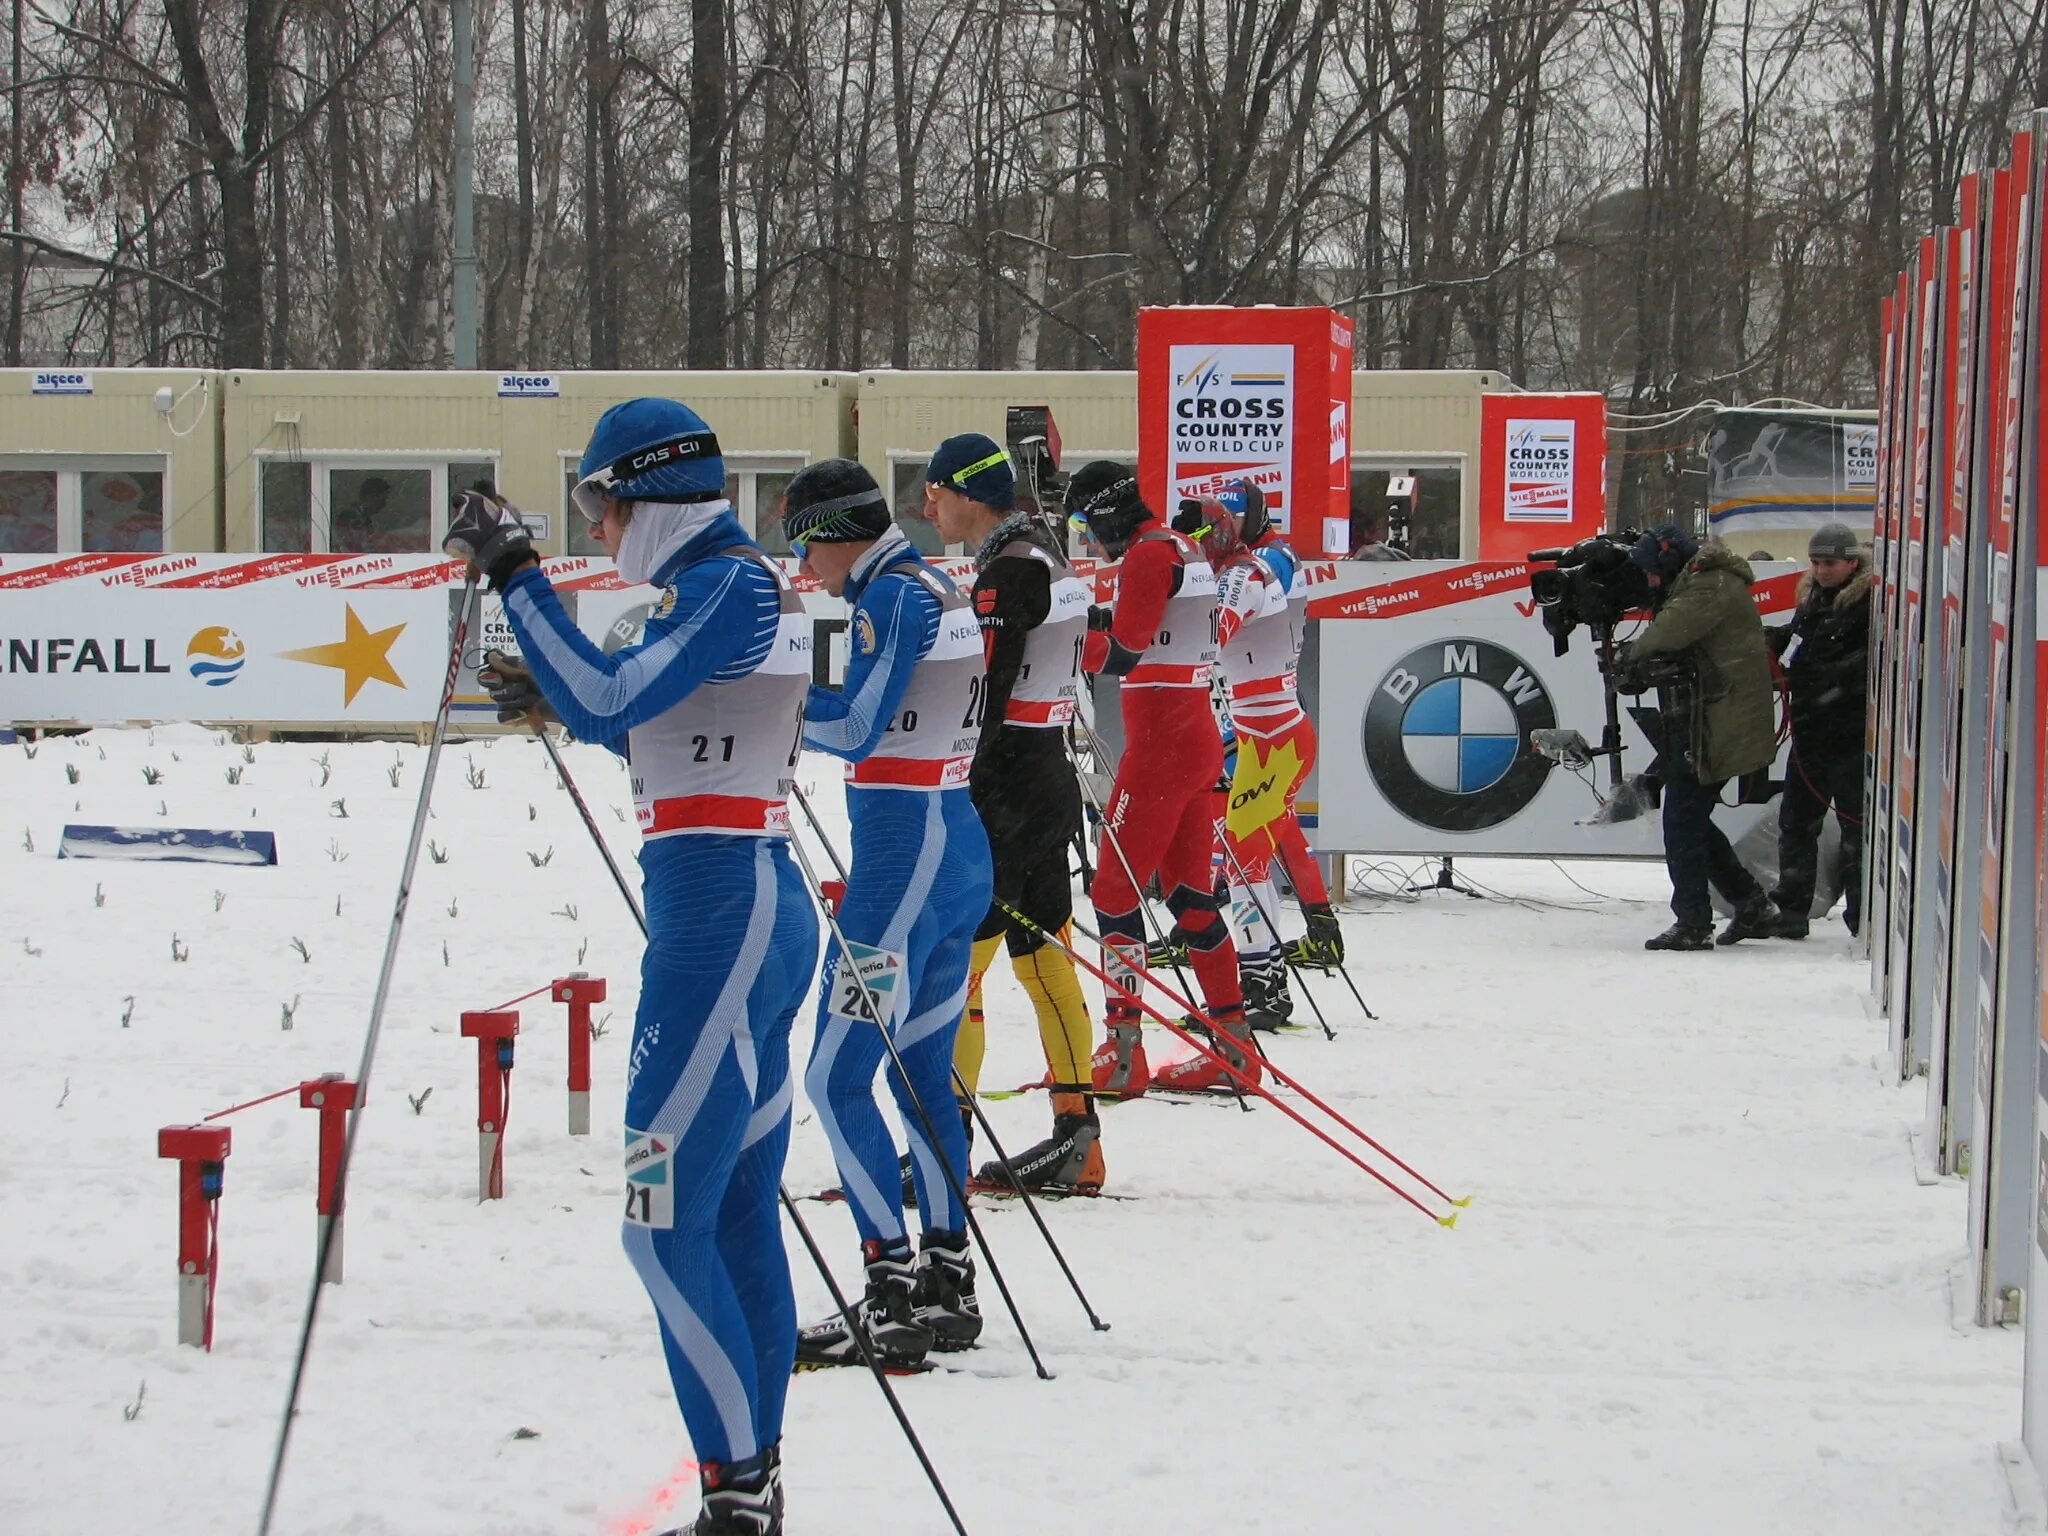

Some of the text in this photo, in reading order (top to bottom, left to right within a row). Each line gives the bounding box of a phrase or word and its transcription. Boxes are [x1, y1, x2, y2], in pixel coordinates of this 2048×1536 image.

[1176, 398, 1284, 418] CROSS
[1176, 423, 1283, 437] COUNTRY
[1176, 440, 1284, 452] WORLD CUP
[1510, 448, 1569, 460] CROSS
[962, 461, 988, 477] adidas
[1510, 461, 1568, 470] COUNTRY
[1511, 488, 1567, 503] VIESSMANN
[64, 557, 109, 572] VIESSMANN
[101, 556, 198, 588] VIESSMANN
[258, 558, 303, 572] VIESSMANN
[297, 557, 393, 588] VIESSMANN
[1447, 565, 1526, 590] VIESSMANN
[1341, 590, 1419, 614] VIESSMANN
[0, 639, 171, 673] NFALL
[1382, 644, 1542, 705] BMW
[692, 735, 735, 762] 21
[1243, 926, 1253, 944] 1
[625, 1182, 650, 1223] 21
